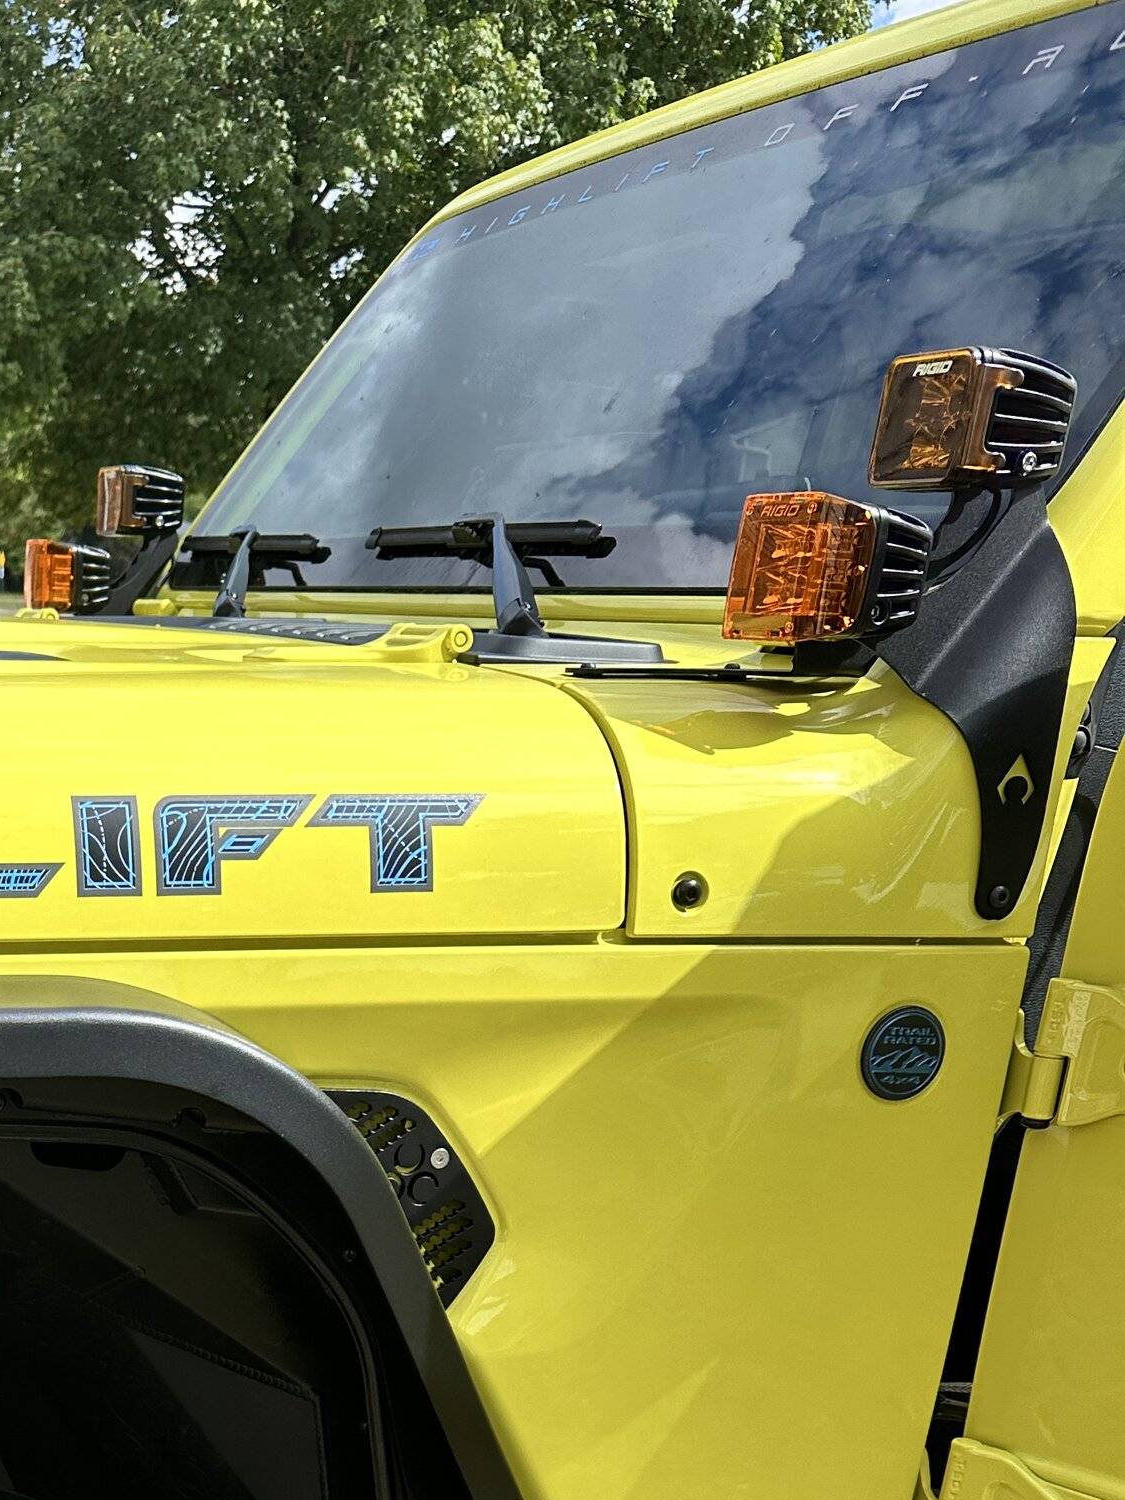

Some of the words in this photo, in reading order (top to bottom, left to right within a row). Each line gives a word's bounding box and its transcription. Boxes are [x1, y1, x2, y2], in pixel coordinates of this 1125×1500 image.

[454, 147, 715, 245] HIGHLIFT
[912, 360, 954, 377] RIGID
[760, 503, 801, 518] RIGID
[889, 1026, 936, 1037] TRAIL
[882, 1034, 937, 1046] RATED
